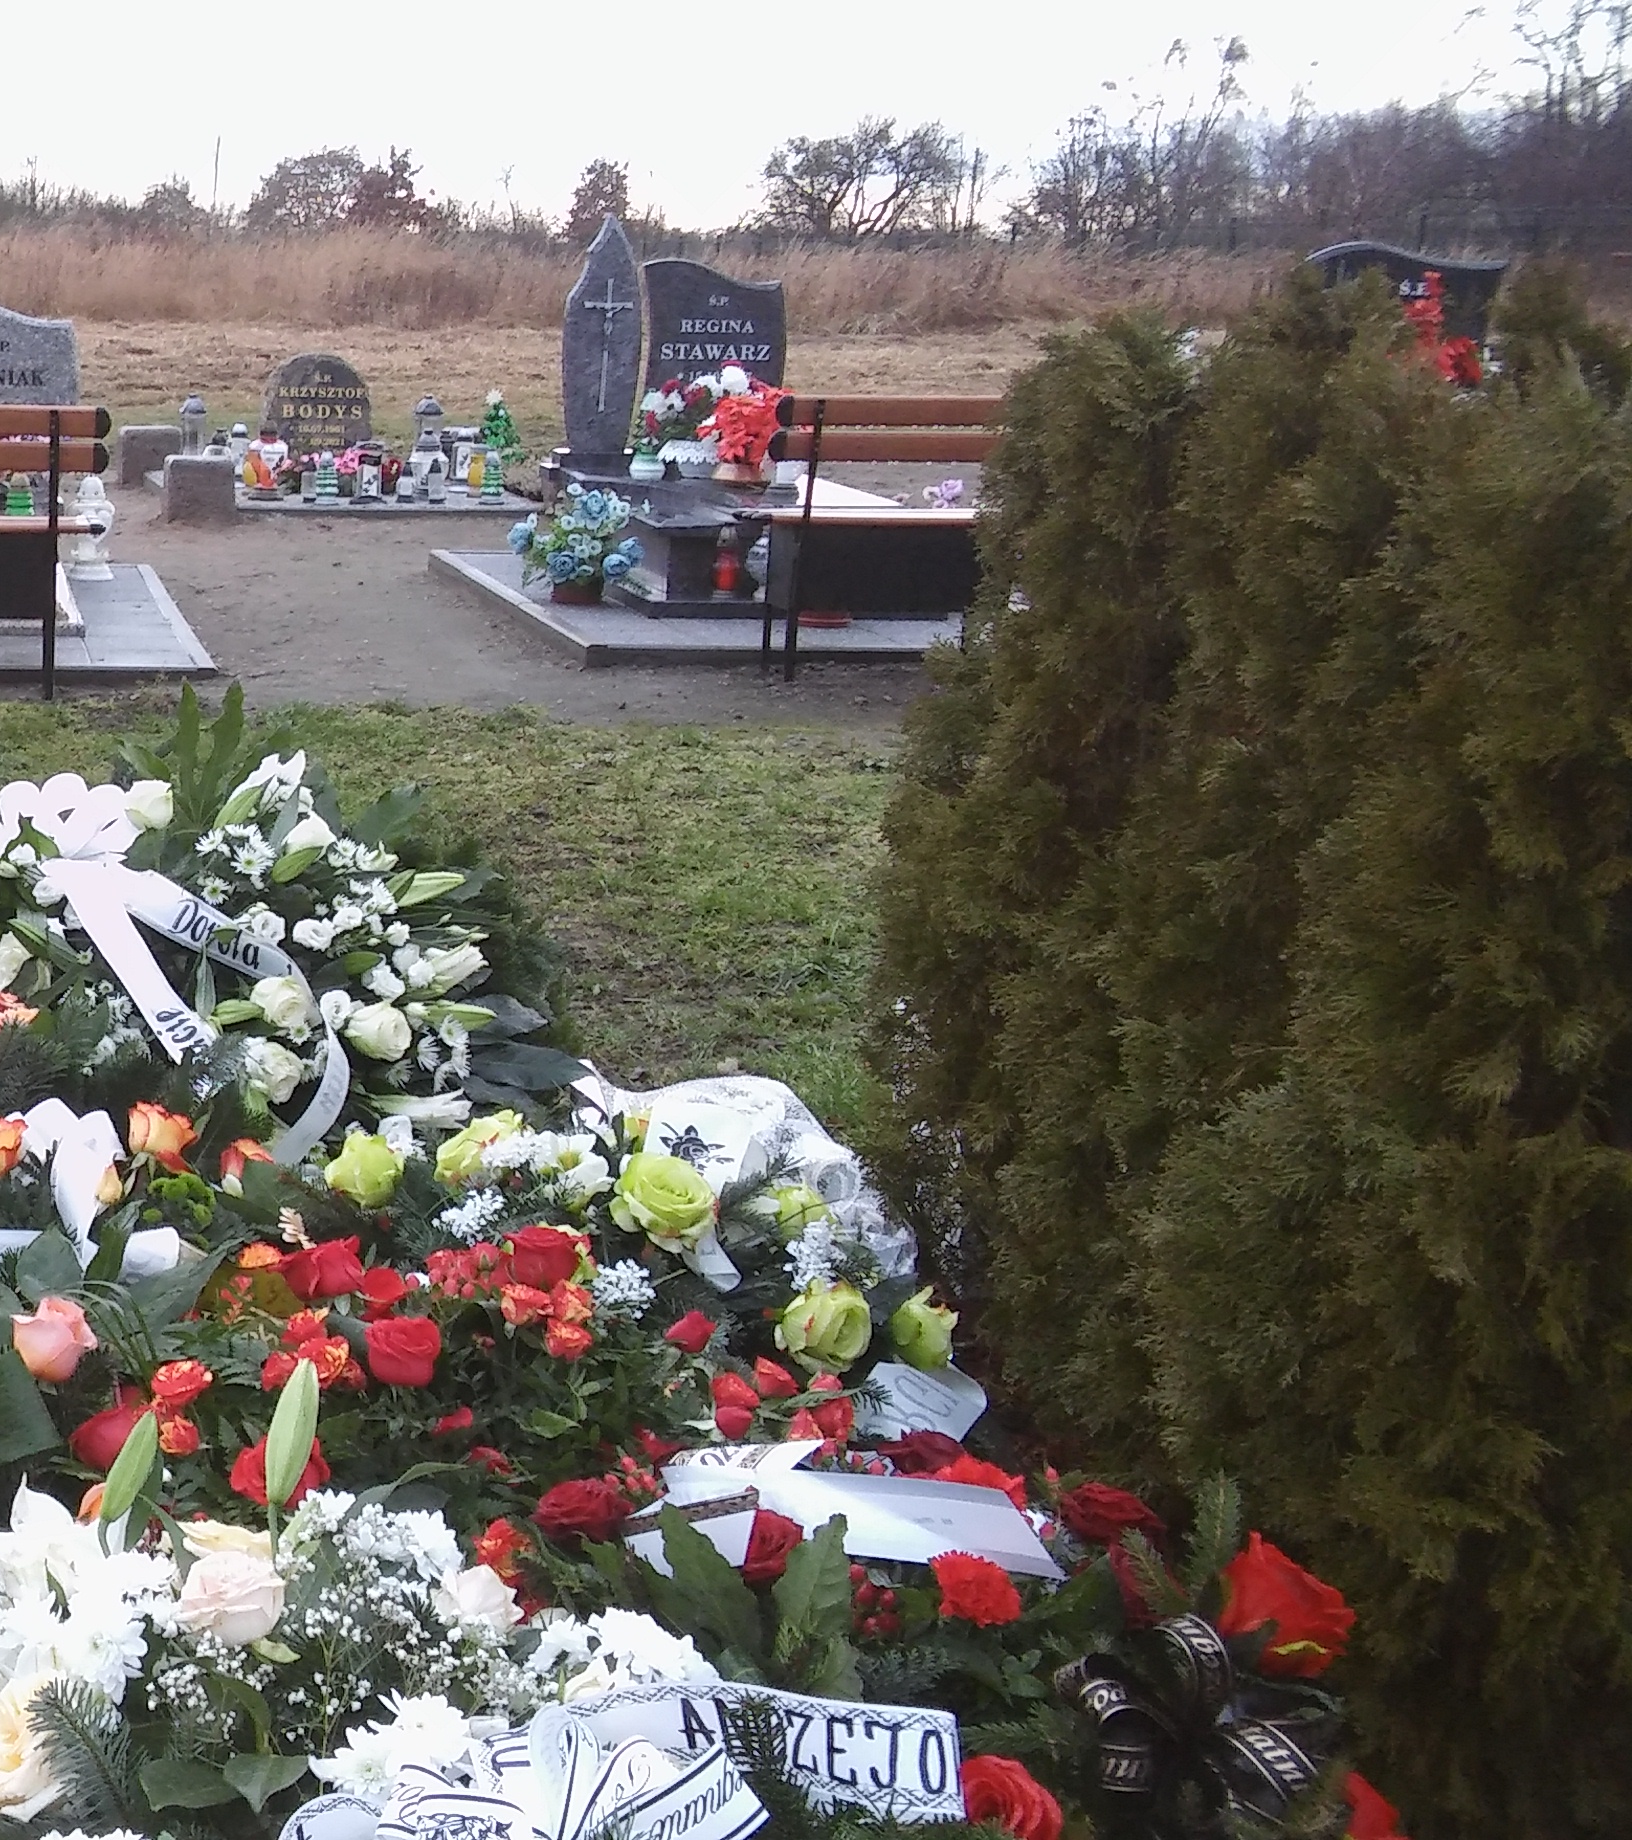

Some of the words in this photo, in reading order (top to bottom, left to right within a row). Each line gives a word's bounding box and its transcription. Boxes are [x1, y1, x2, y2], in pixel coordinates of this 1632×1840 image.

[680, 319, 755, 334] REGINA
[660, 343, 771, 361] STAWARZ
[279, 386, 366, 399] KRZYSZTOF
[281, 403, 363, 419] BODYS
